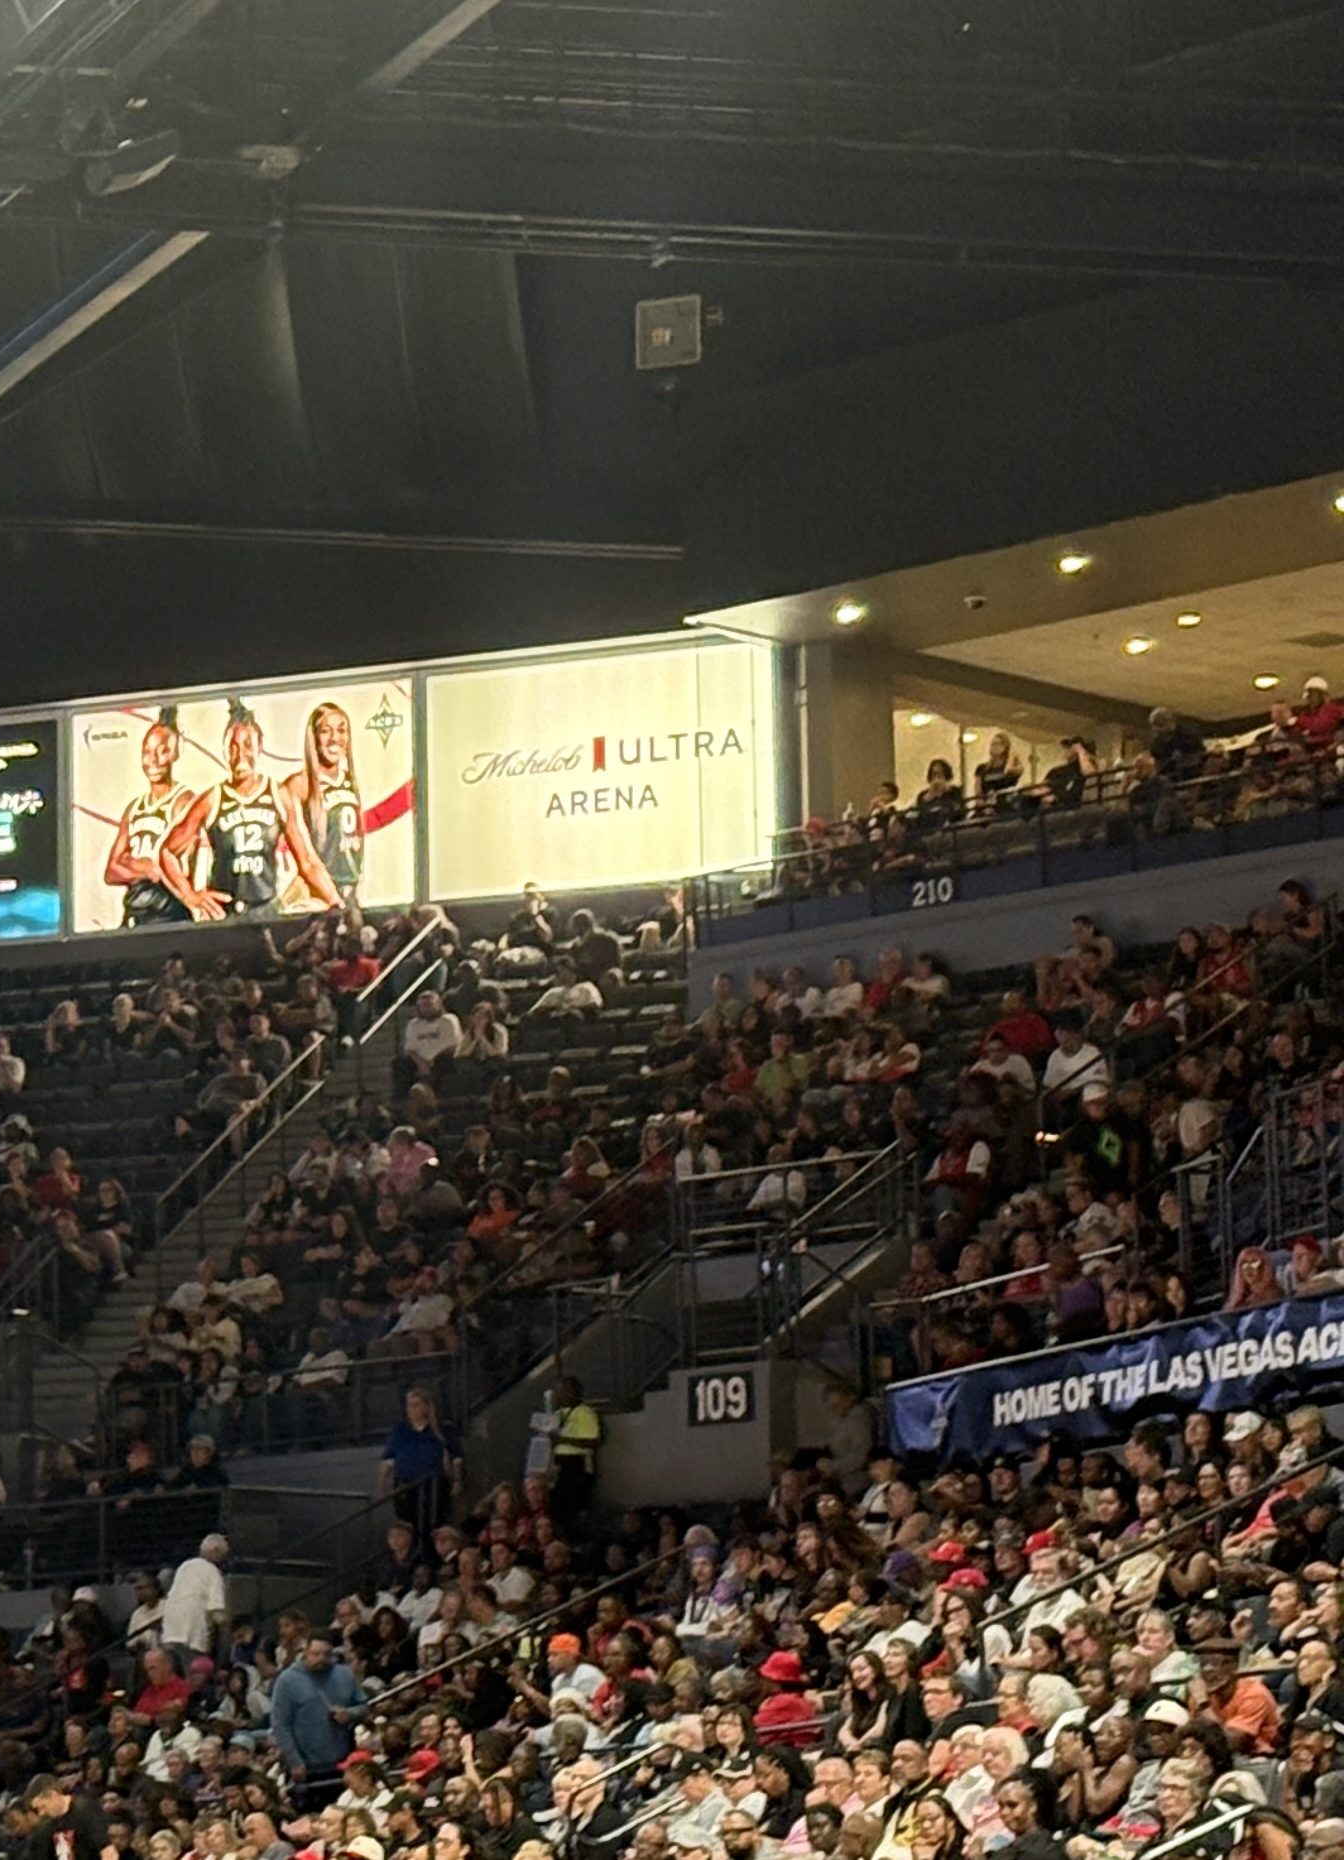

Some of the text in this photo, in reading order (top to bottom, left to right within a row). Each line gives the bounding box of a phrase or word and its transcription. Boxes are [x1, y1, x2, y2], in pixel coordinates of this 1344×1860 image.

[462, 728, 743, 784] Michelob ULTRA
[546, 784, 658, 818] ARENA
[233, 823, 264, 852] 12
[912, 876, 953, 907] 210
[695, 1376, 747, 1421] 109
[993, 1380, 1062, 1427] HOME
[1063, 1373, 1097, 1413] OF
[1098, 1364, 1148, 1405] THE
[1148, 1351, 1204, 1395] LAS
[1204, 1331, 1295, 1382] VEGAS
